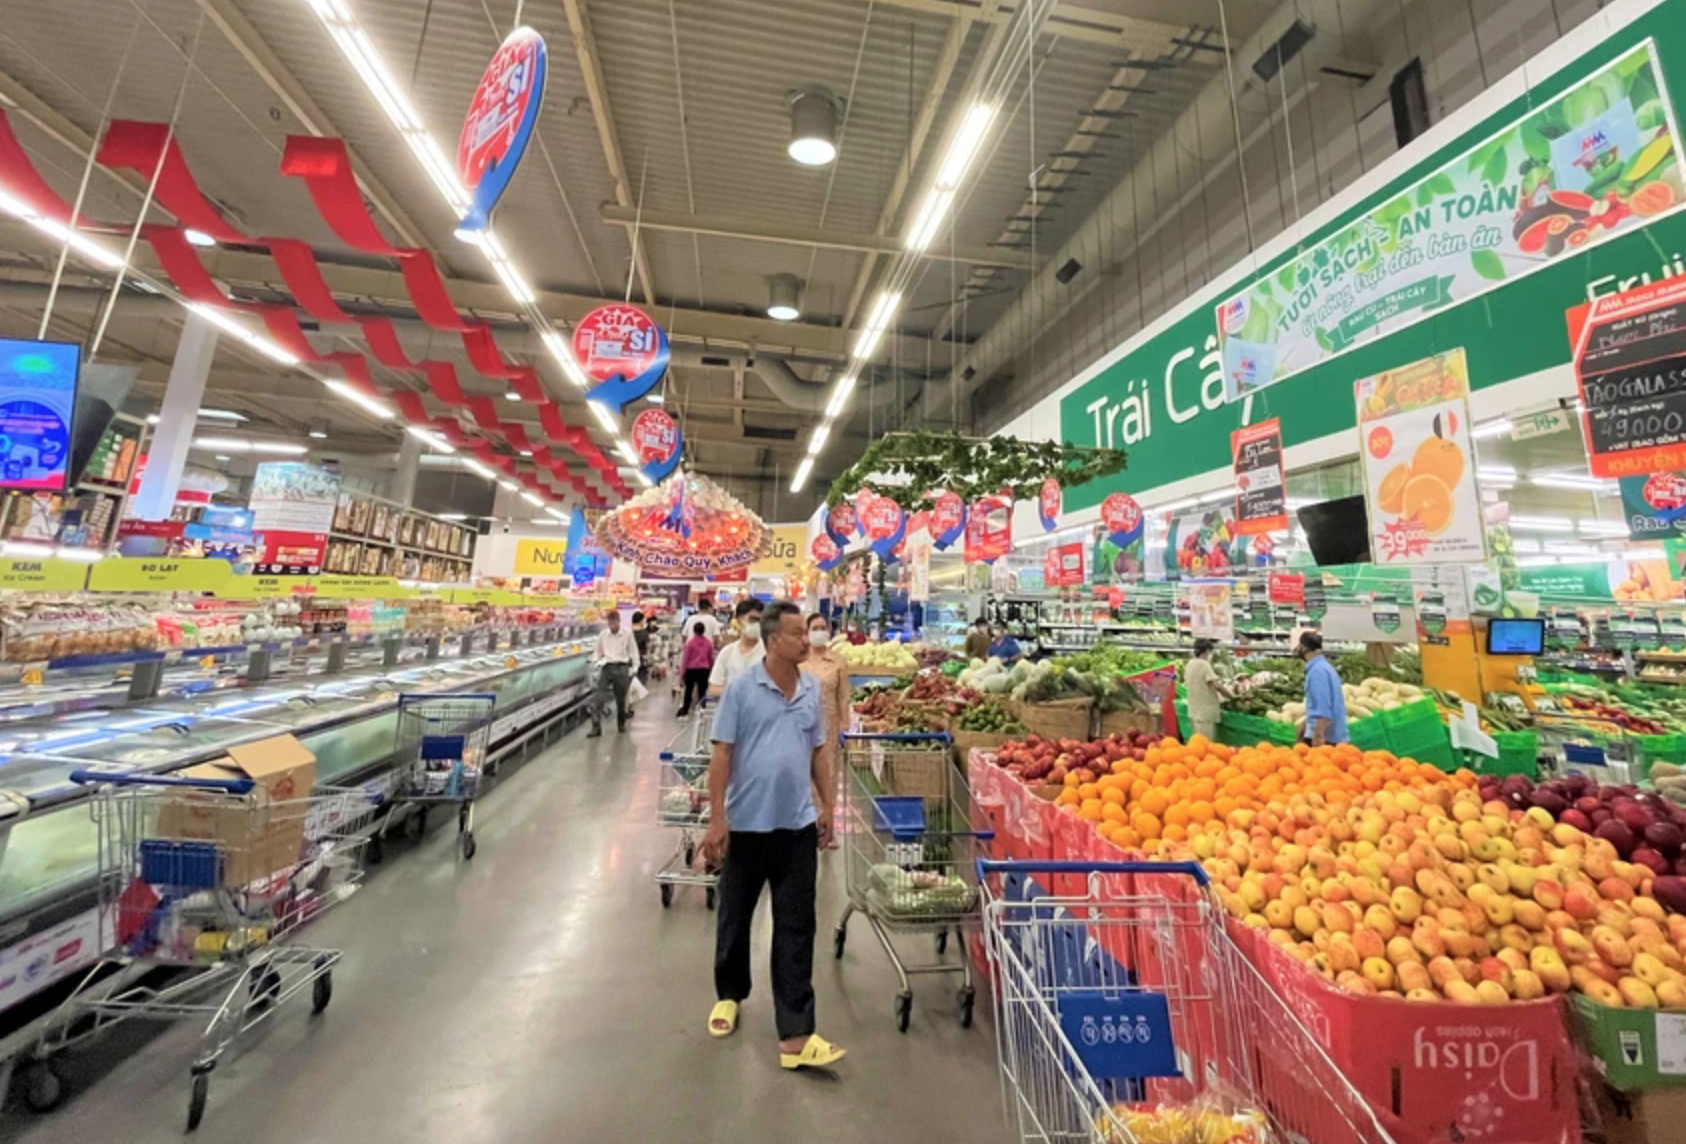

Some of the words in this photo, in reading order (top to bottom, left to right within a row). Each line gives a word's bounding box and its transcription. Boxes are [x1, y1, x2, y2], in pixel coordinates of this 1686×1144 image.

[1319, 238, 1372, 288] SẠCH
[1399, 207, 1431, 239] AN
[1441, 183, 1518, 223] TOÀN
[1426, 231, 1468, 260] bàn
[1469, 224, 1503, 250] ăn
[1086, 378, 1152, 450] Trái
[1413, 1026, 1539, 1101] Daisy
